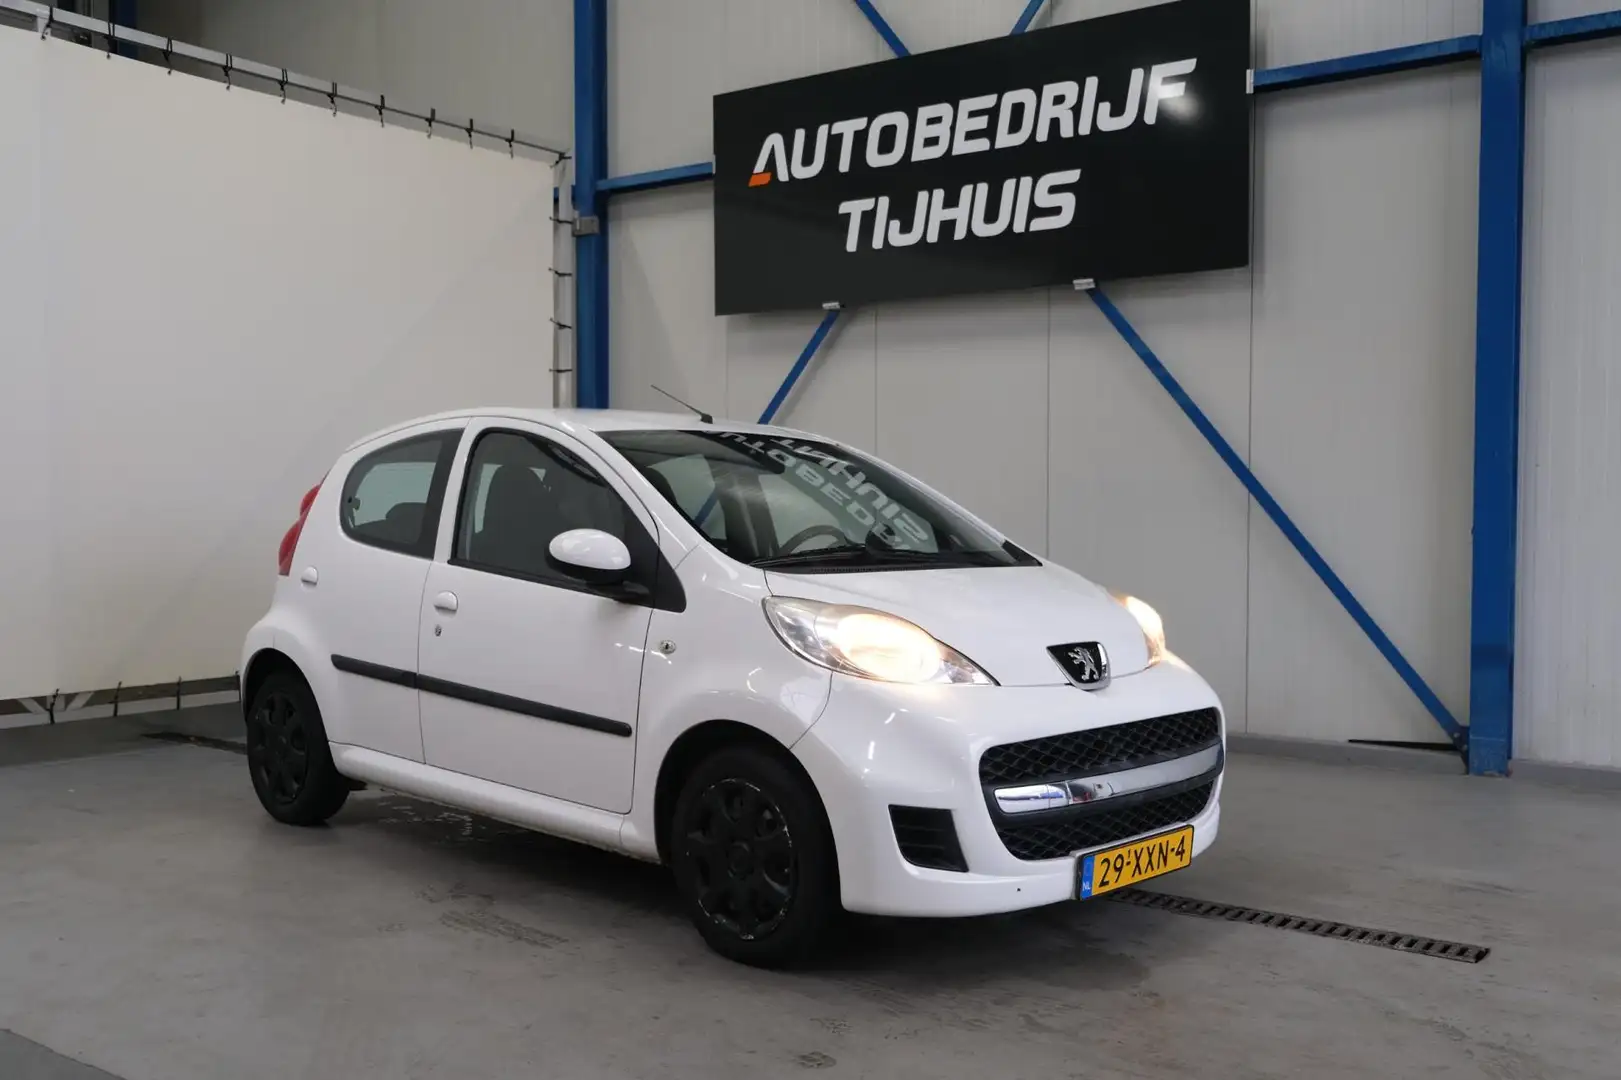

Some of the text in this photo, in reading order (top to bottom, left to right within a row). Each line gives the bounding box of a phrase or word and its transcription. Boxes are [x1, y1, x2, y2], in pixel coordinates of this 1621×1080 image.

[748, 57, 1198, 187] AUTOBEDRIJF
[838, 168, 1082, 253] TIJHUIS
[1082, 881, 1092, 892] NL
[1098, 835, 1186, 888] 29-XXN-4
